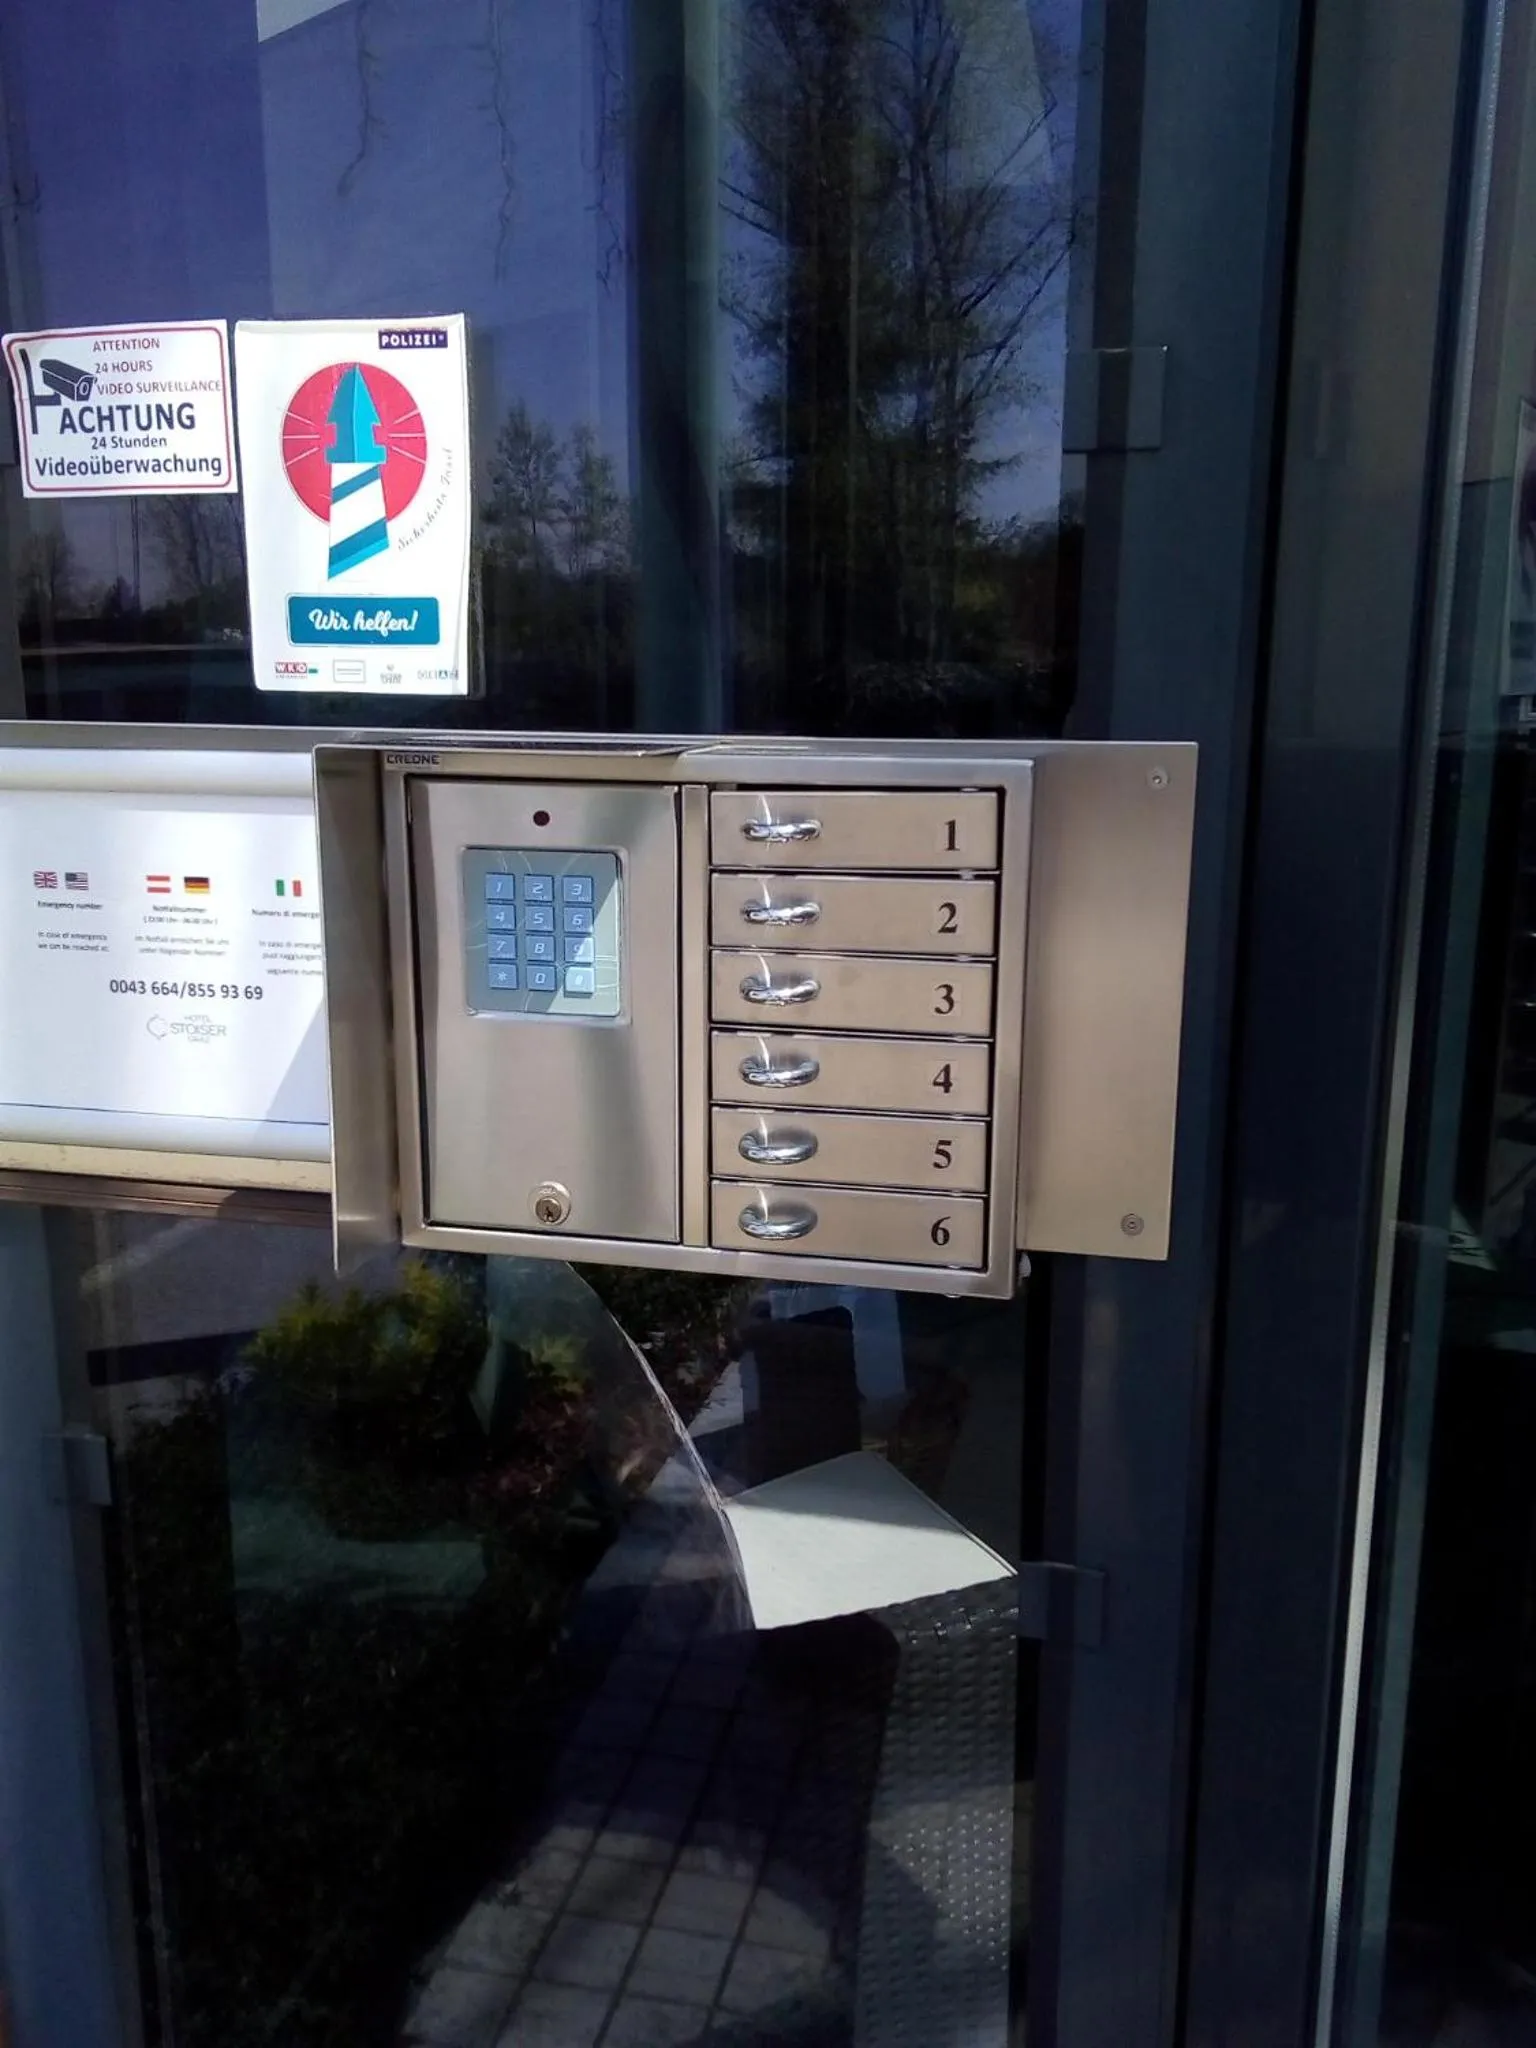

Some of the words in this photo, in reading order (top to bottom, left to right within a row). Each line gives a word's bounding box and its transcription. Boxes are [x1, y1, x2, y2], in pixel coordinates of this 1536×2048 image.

[92, 337, 161, 353] ATTENTION
[381, 333, 437, 347] POLIZEI
[95, 362, 108, 374] 24
[111, 360, 153, 373] HOURS
[97, 381, 134, 396] VIDEO
[136, 379, 222, 394] SURVEILLANCE
[59, 402, 196, 435] ACHTUNG
[91, 436, 107, 450] 24
[111, 434, 168, 449] Stunden
[35, 453, 222, 477] Videoüberwachung
[308, 608, 350, 631] Wir
[354, 609, 418, 637] helfen!
[944, 819, 960, 851] 1
[532, 883, 544, 894] 2
[571, 884, 582, 895] 3
[494, 911, 505, 922] 4
[533, 912, 544, 924] 5
[572, 915, 583, 926] 6
[937, 902, 959, 933] 2
[534, 943, 545, 953] 8
[535, 973, 546, 984] 0
[109, 979, 147, 995] 0043
[151, 981, 216, 999] 664/855
[220, 984, 239, 999] 93
[244, 985, 263, 1000] 69
[934, 984, 955, 1014] 3
[932, 1064, 953, 1094] 4
[933, 1140, 952, 1169] 5
[930, 1217, 950, 1246] 6
